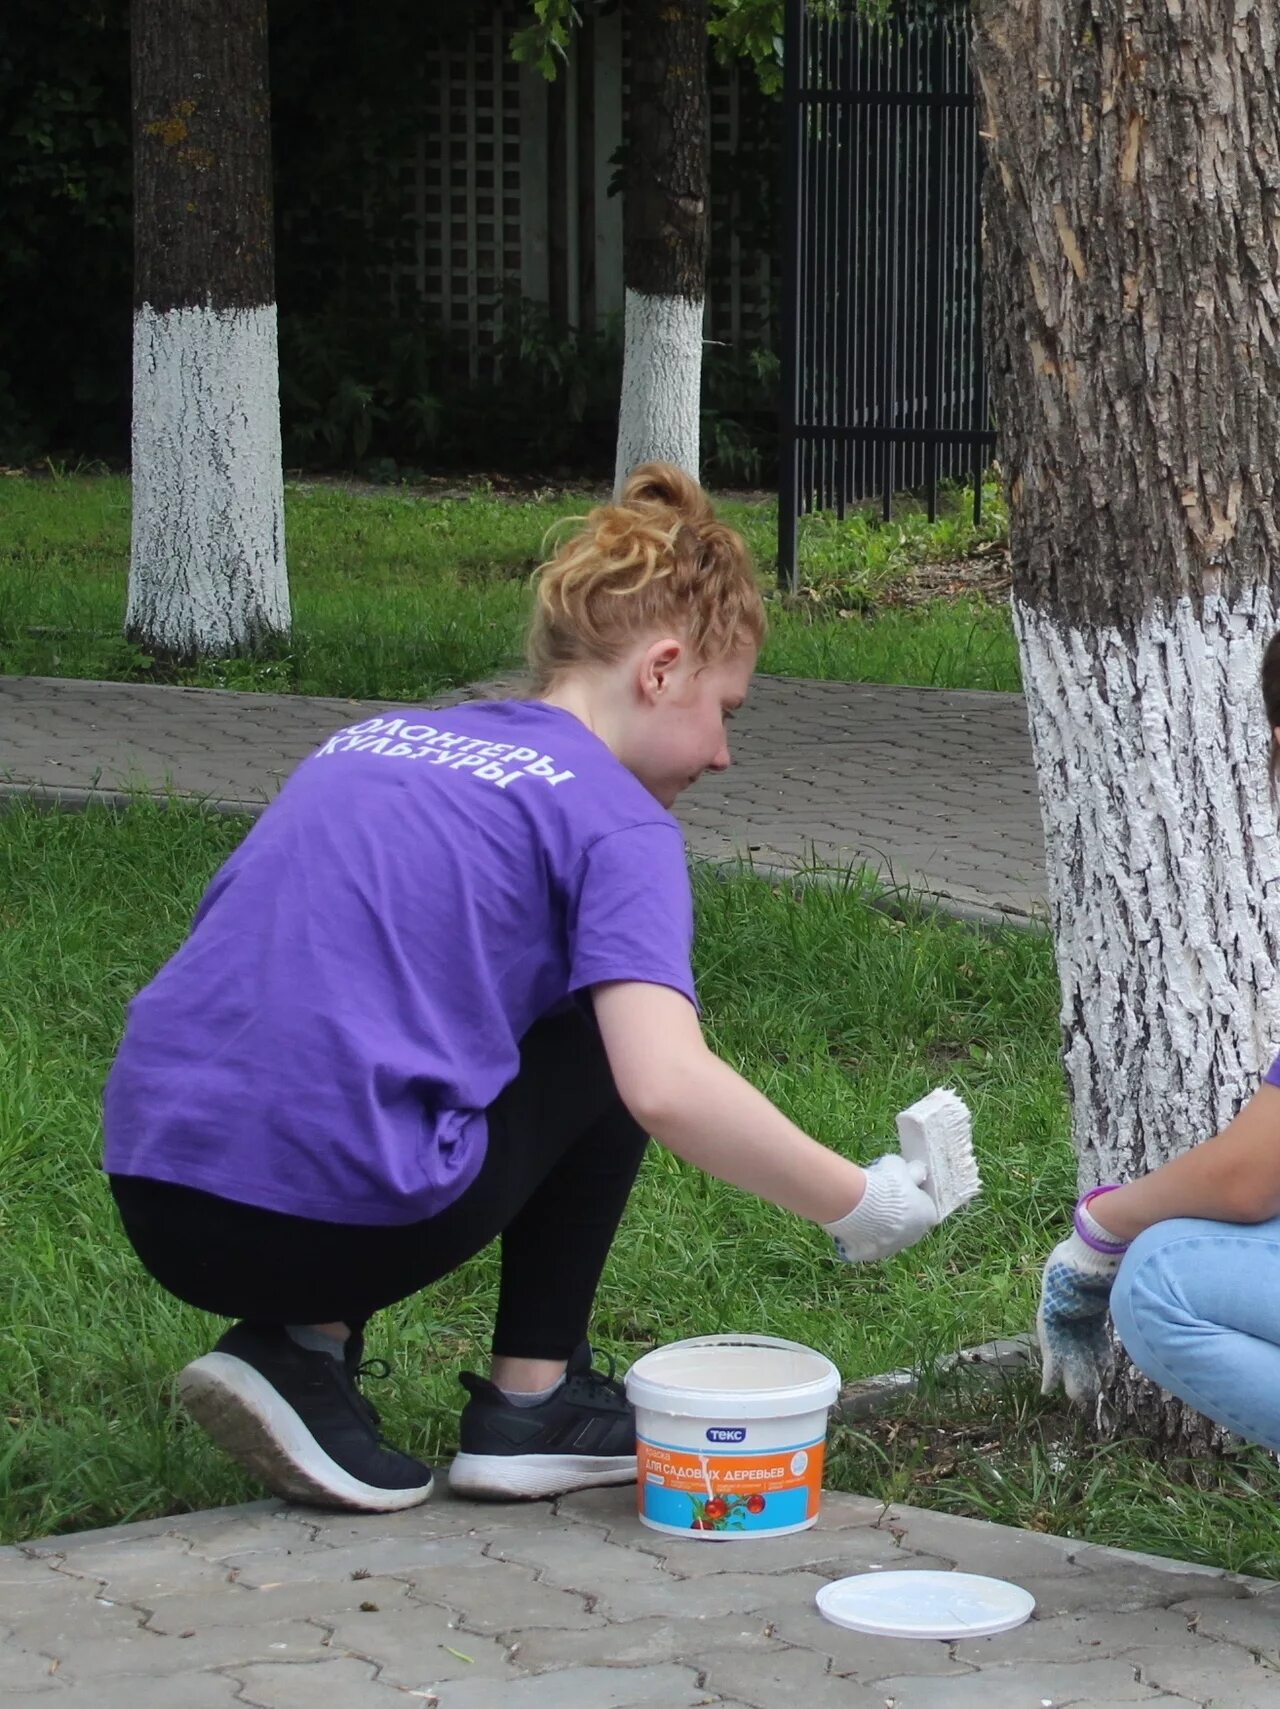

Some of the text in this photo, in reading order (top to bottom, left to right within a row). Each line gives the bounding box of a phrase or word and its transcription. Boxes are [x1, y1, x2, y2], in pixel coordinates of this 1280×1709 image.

[315, 735, 526, 788] КУЛЬТУРЫ
[339, 718, 576, 787] ОЛОНТЕРЫ
[645, 1458, 662, 1473] ДЛЯ
[724, 1467, 785, 1481] ДЕРЕВЬЕВ
